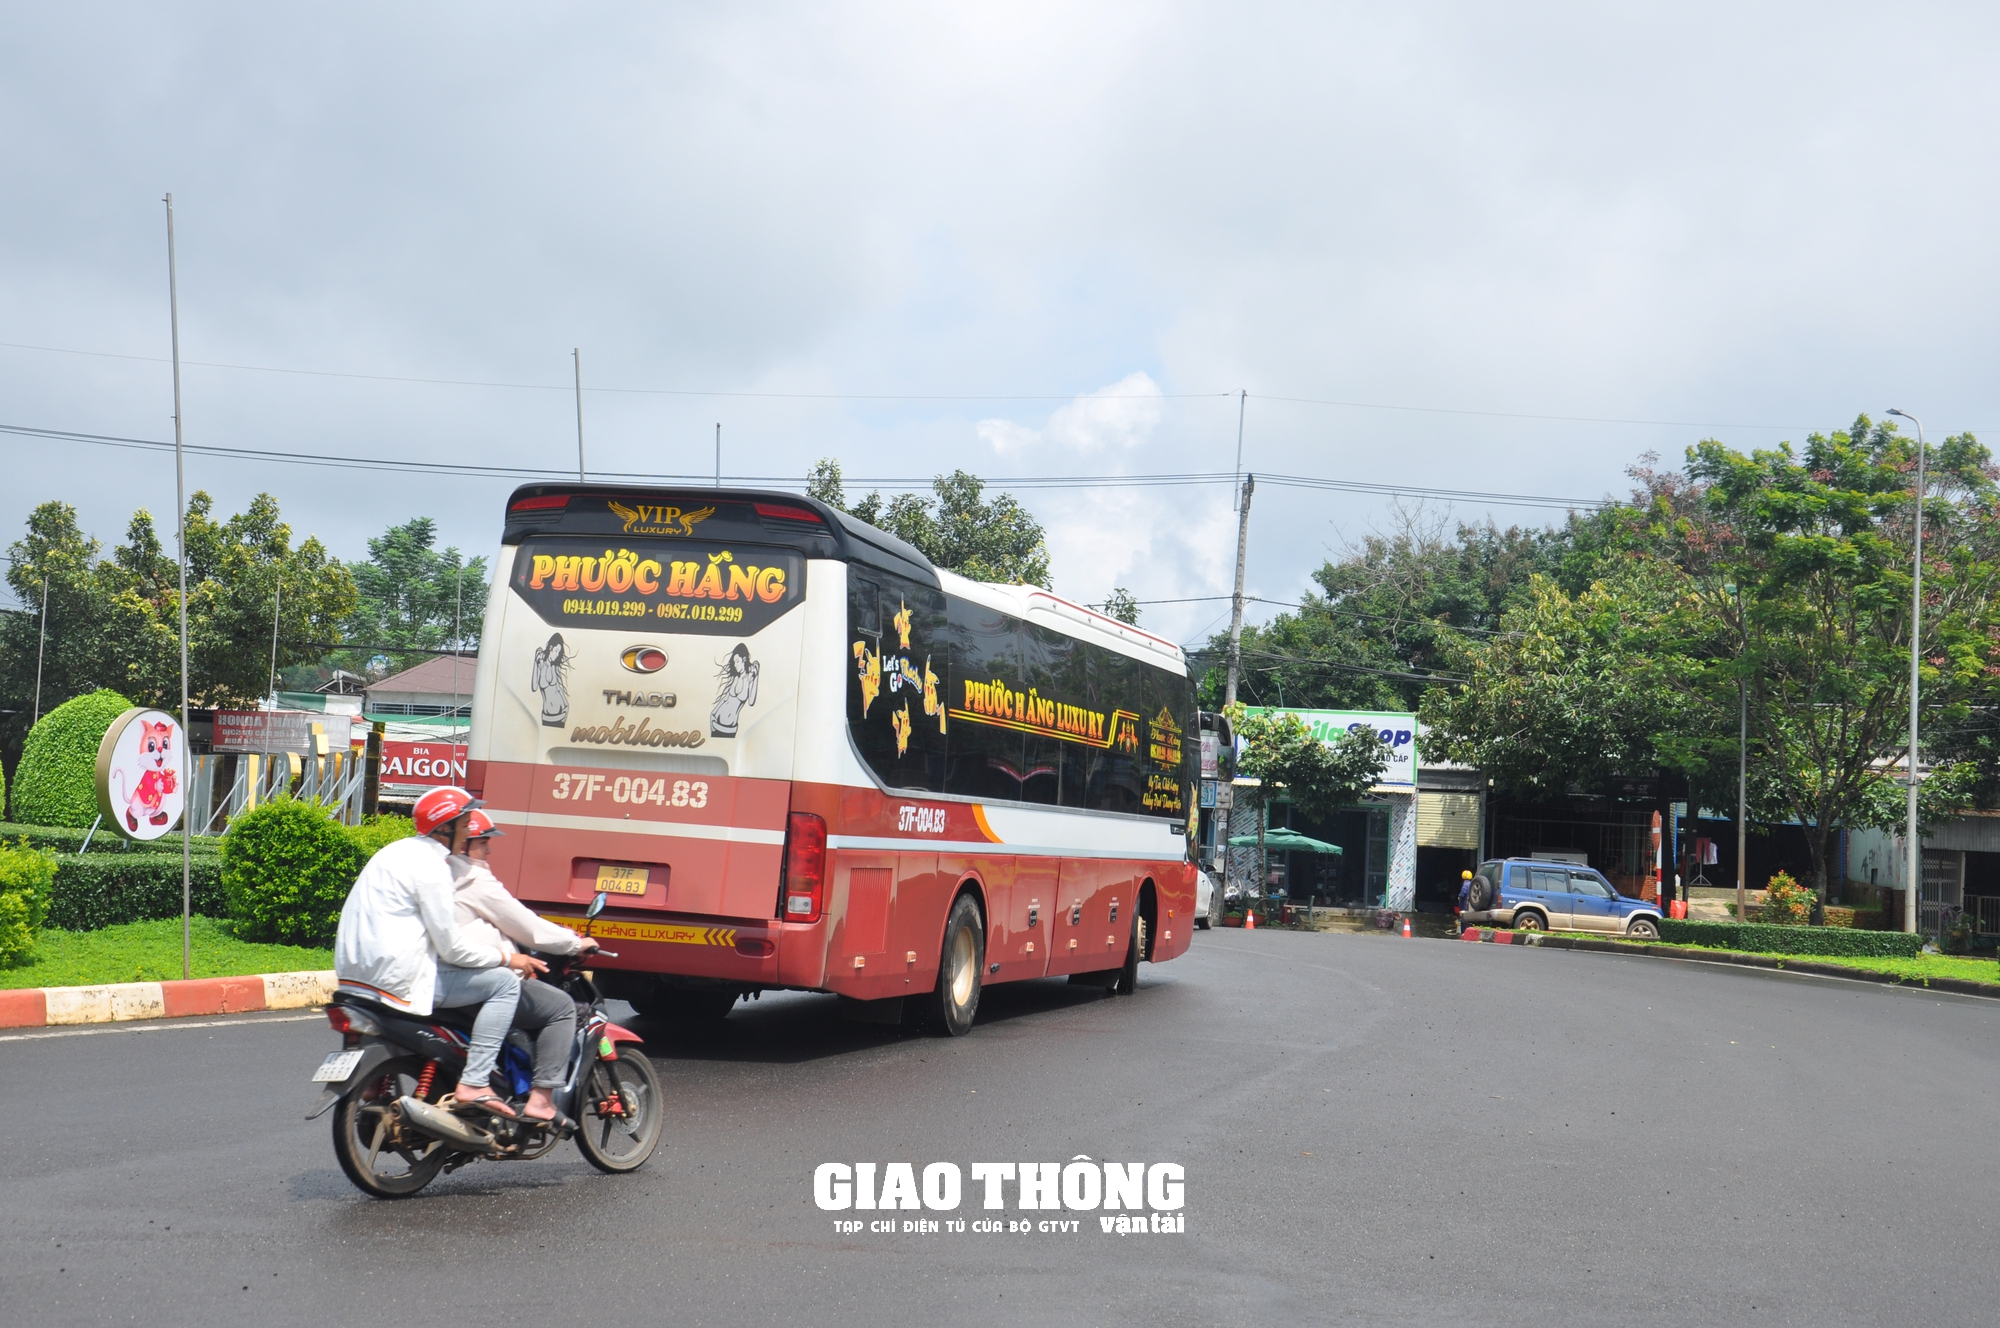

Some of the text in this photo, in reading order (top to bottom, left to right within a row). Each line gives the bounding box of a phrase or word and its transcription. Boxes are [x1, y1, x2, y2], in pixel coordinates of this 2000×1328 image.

[636, 505, 681, 524] VIP
[633, 526, 682, 535] LUXURY
[529, 548, 662, 595] PHƯỚC
[563, 598, 646, 617] 0944.019.299
[657, 603, 743, 623] 0987.019.299
[883, 655, 899, 672] Let's
[603, 689, 677, 708] THACO
[964, 679, 1013, 719] PHƯỚC
[1056, 702, 1105, 739] LUXURY
[218, 714, 263, 727] HONDA
[570, 715, 706, 749] mobihome
[413, 747, 430, 755] BIA
[552, 772, 709, 809] 37F-004.83
[898, 805, 946, 834] 37F-004.83
[612, 867, 634, 879] 37F
[600, 879, 640, 893] 004.83
[640, 928, 696, 942] LUXURY
